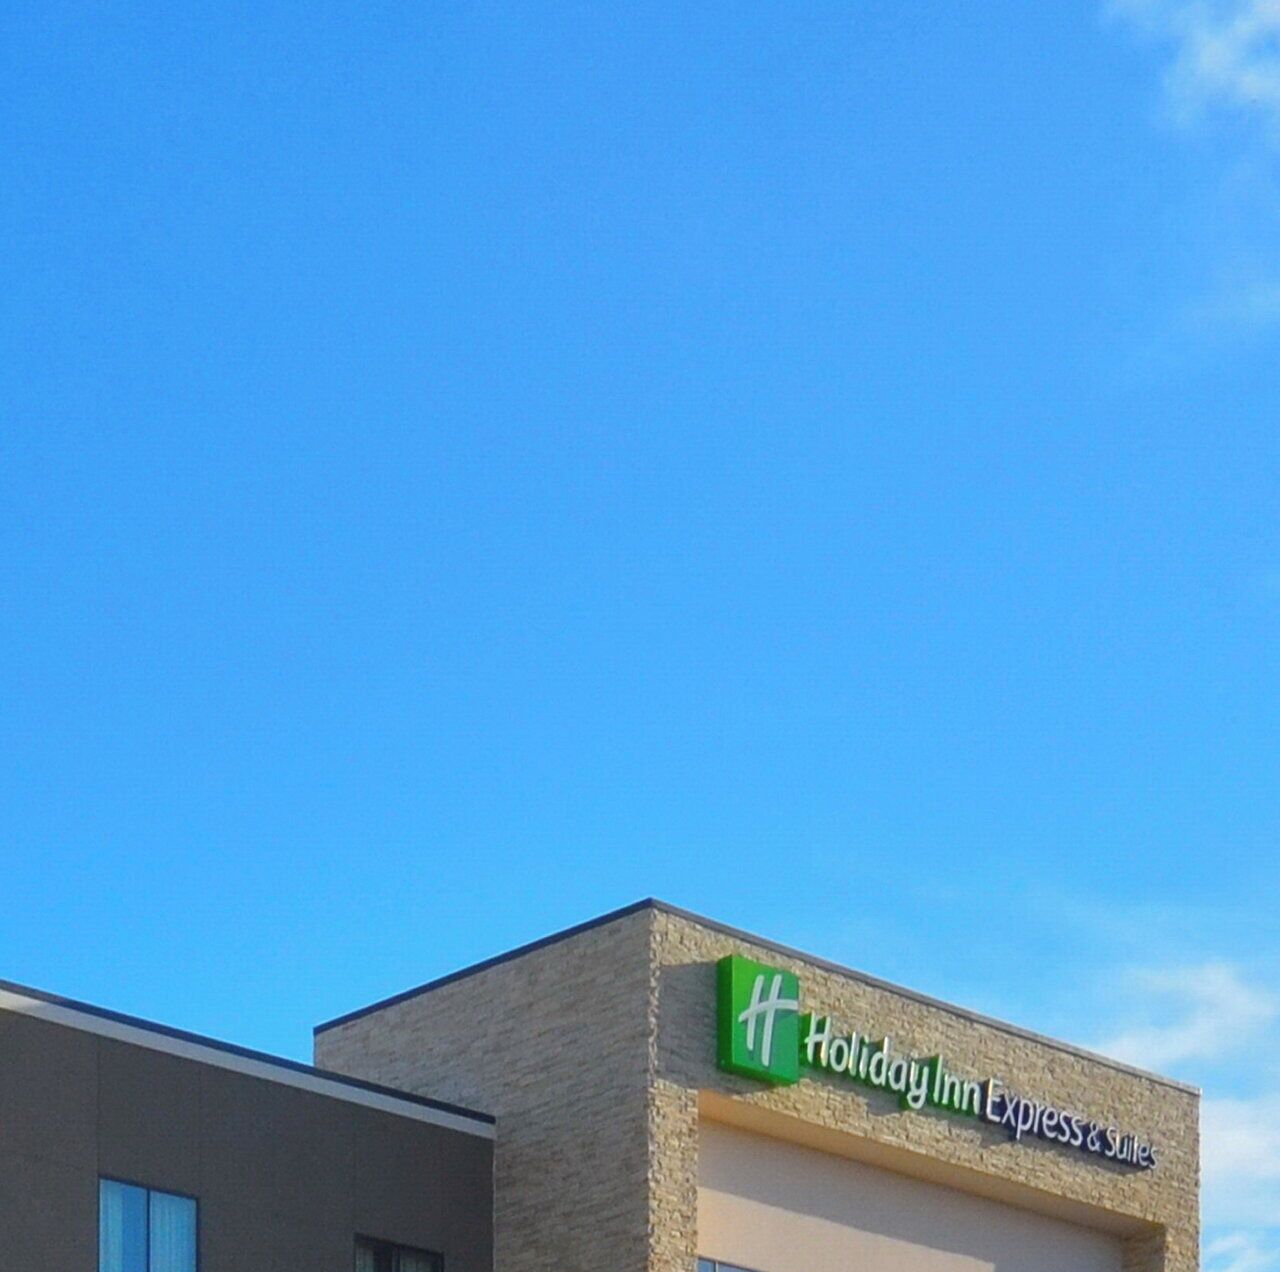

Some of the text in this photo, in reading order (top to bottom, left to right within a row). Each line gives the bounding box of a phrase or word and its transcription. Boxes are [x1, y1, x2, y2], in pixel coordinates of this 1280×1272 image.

[804, 1010, 1158, 1169] Holiday Inn Express & Suites
